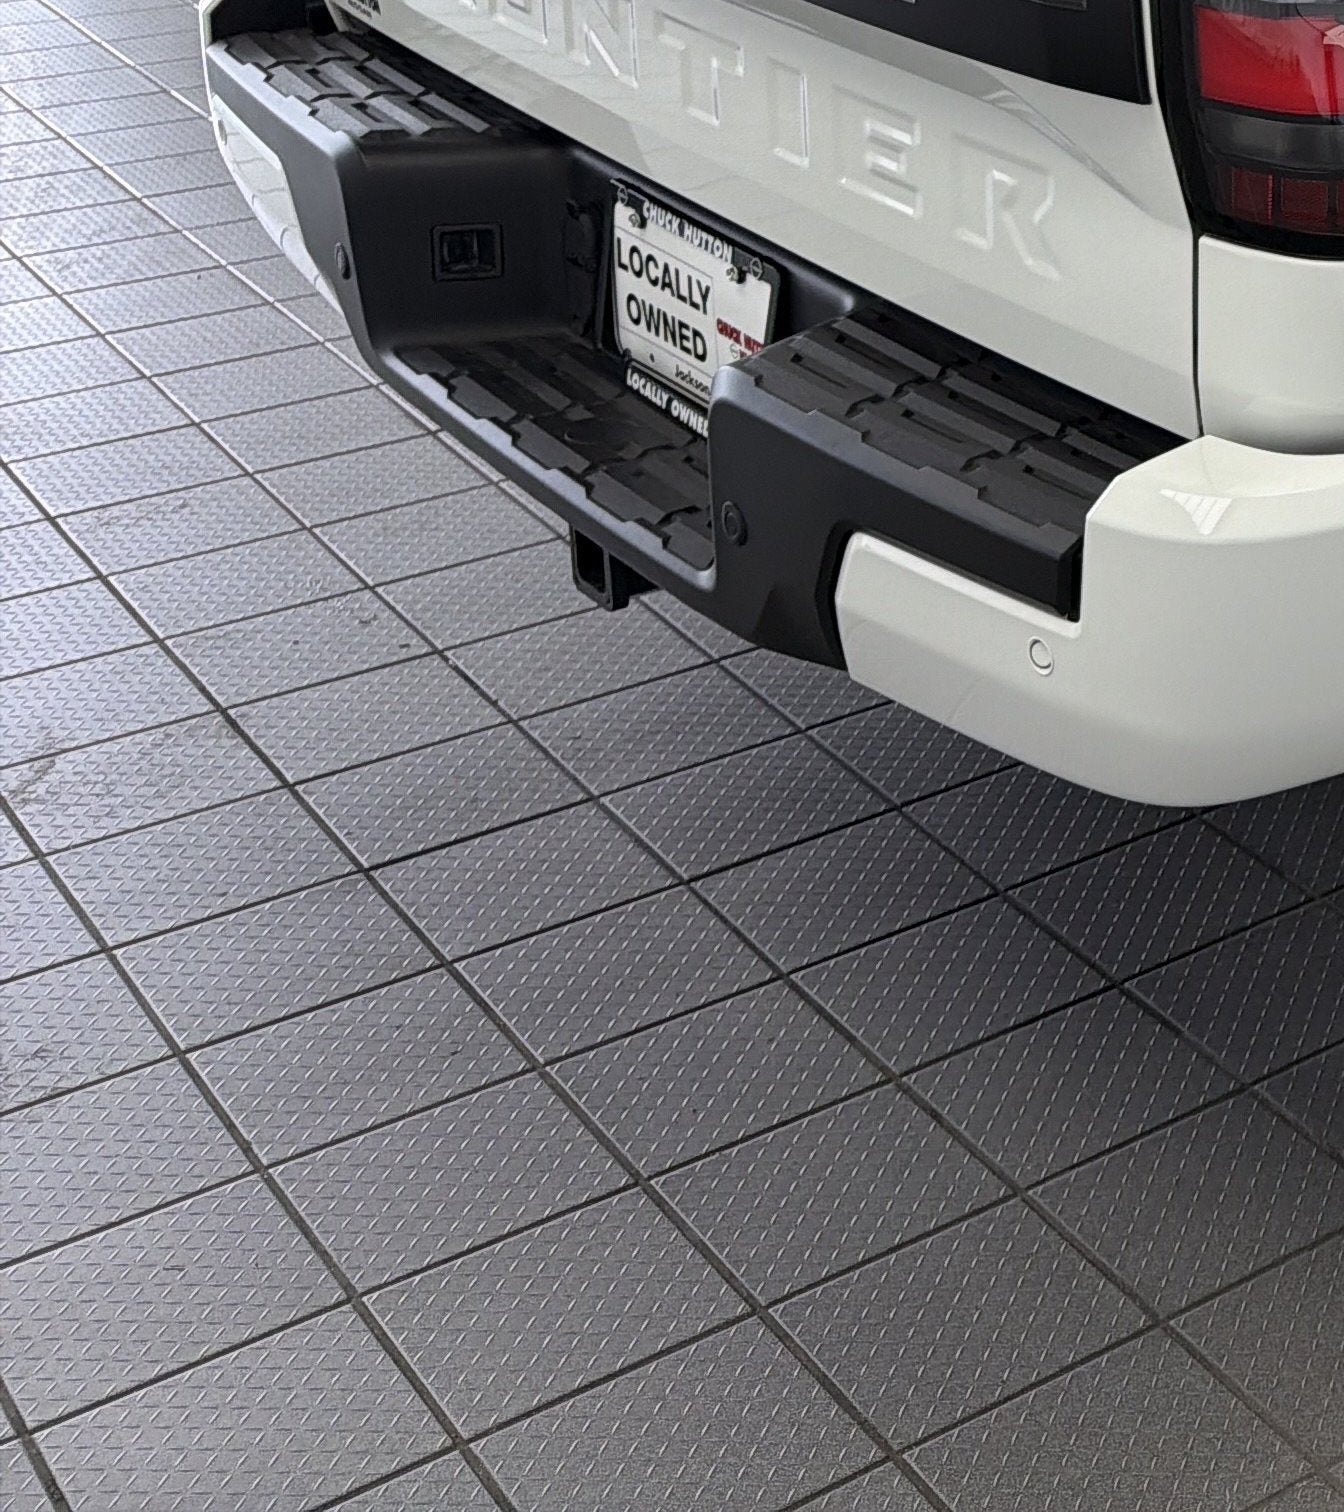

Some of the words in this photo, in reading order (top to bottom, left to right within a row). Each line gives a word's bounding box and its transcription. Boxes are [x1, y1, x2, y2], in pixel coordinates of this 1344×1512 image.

[643, 199, 681, 238] CHUCK
[684, 220, 733, 264] HUTTON
[617, 237, 710, 315] LOCALLY
[627, 293, 707, 363] OWNED
[626, 367, 670, 410] LOCALLY
